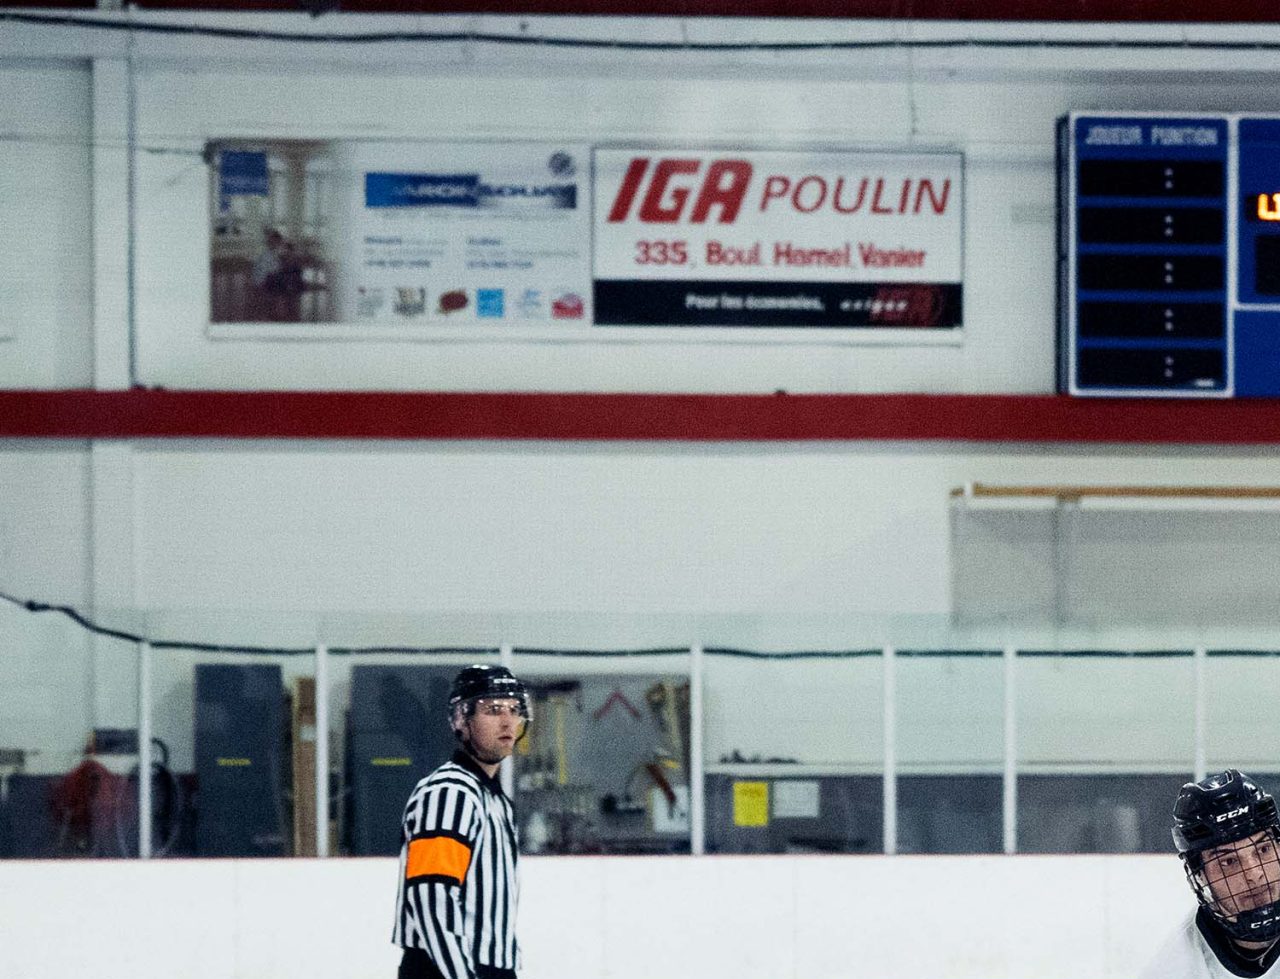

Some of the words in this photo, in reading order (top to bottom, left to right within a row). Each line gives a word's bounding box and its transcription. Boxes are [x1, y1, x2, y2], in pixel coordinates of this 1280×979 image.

[607, 157, 753, 224] IGA
[760, 175, 952, 215] POULIN
[858, 242, 926, 268] Vanier
[1216, 806, 1249, 823] CCM
